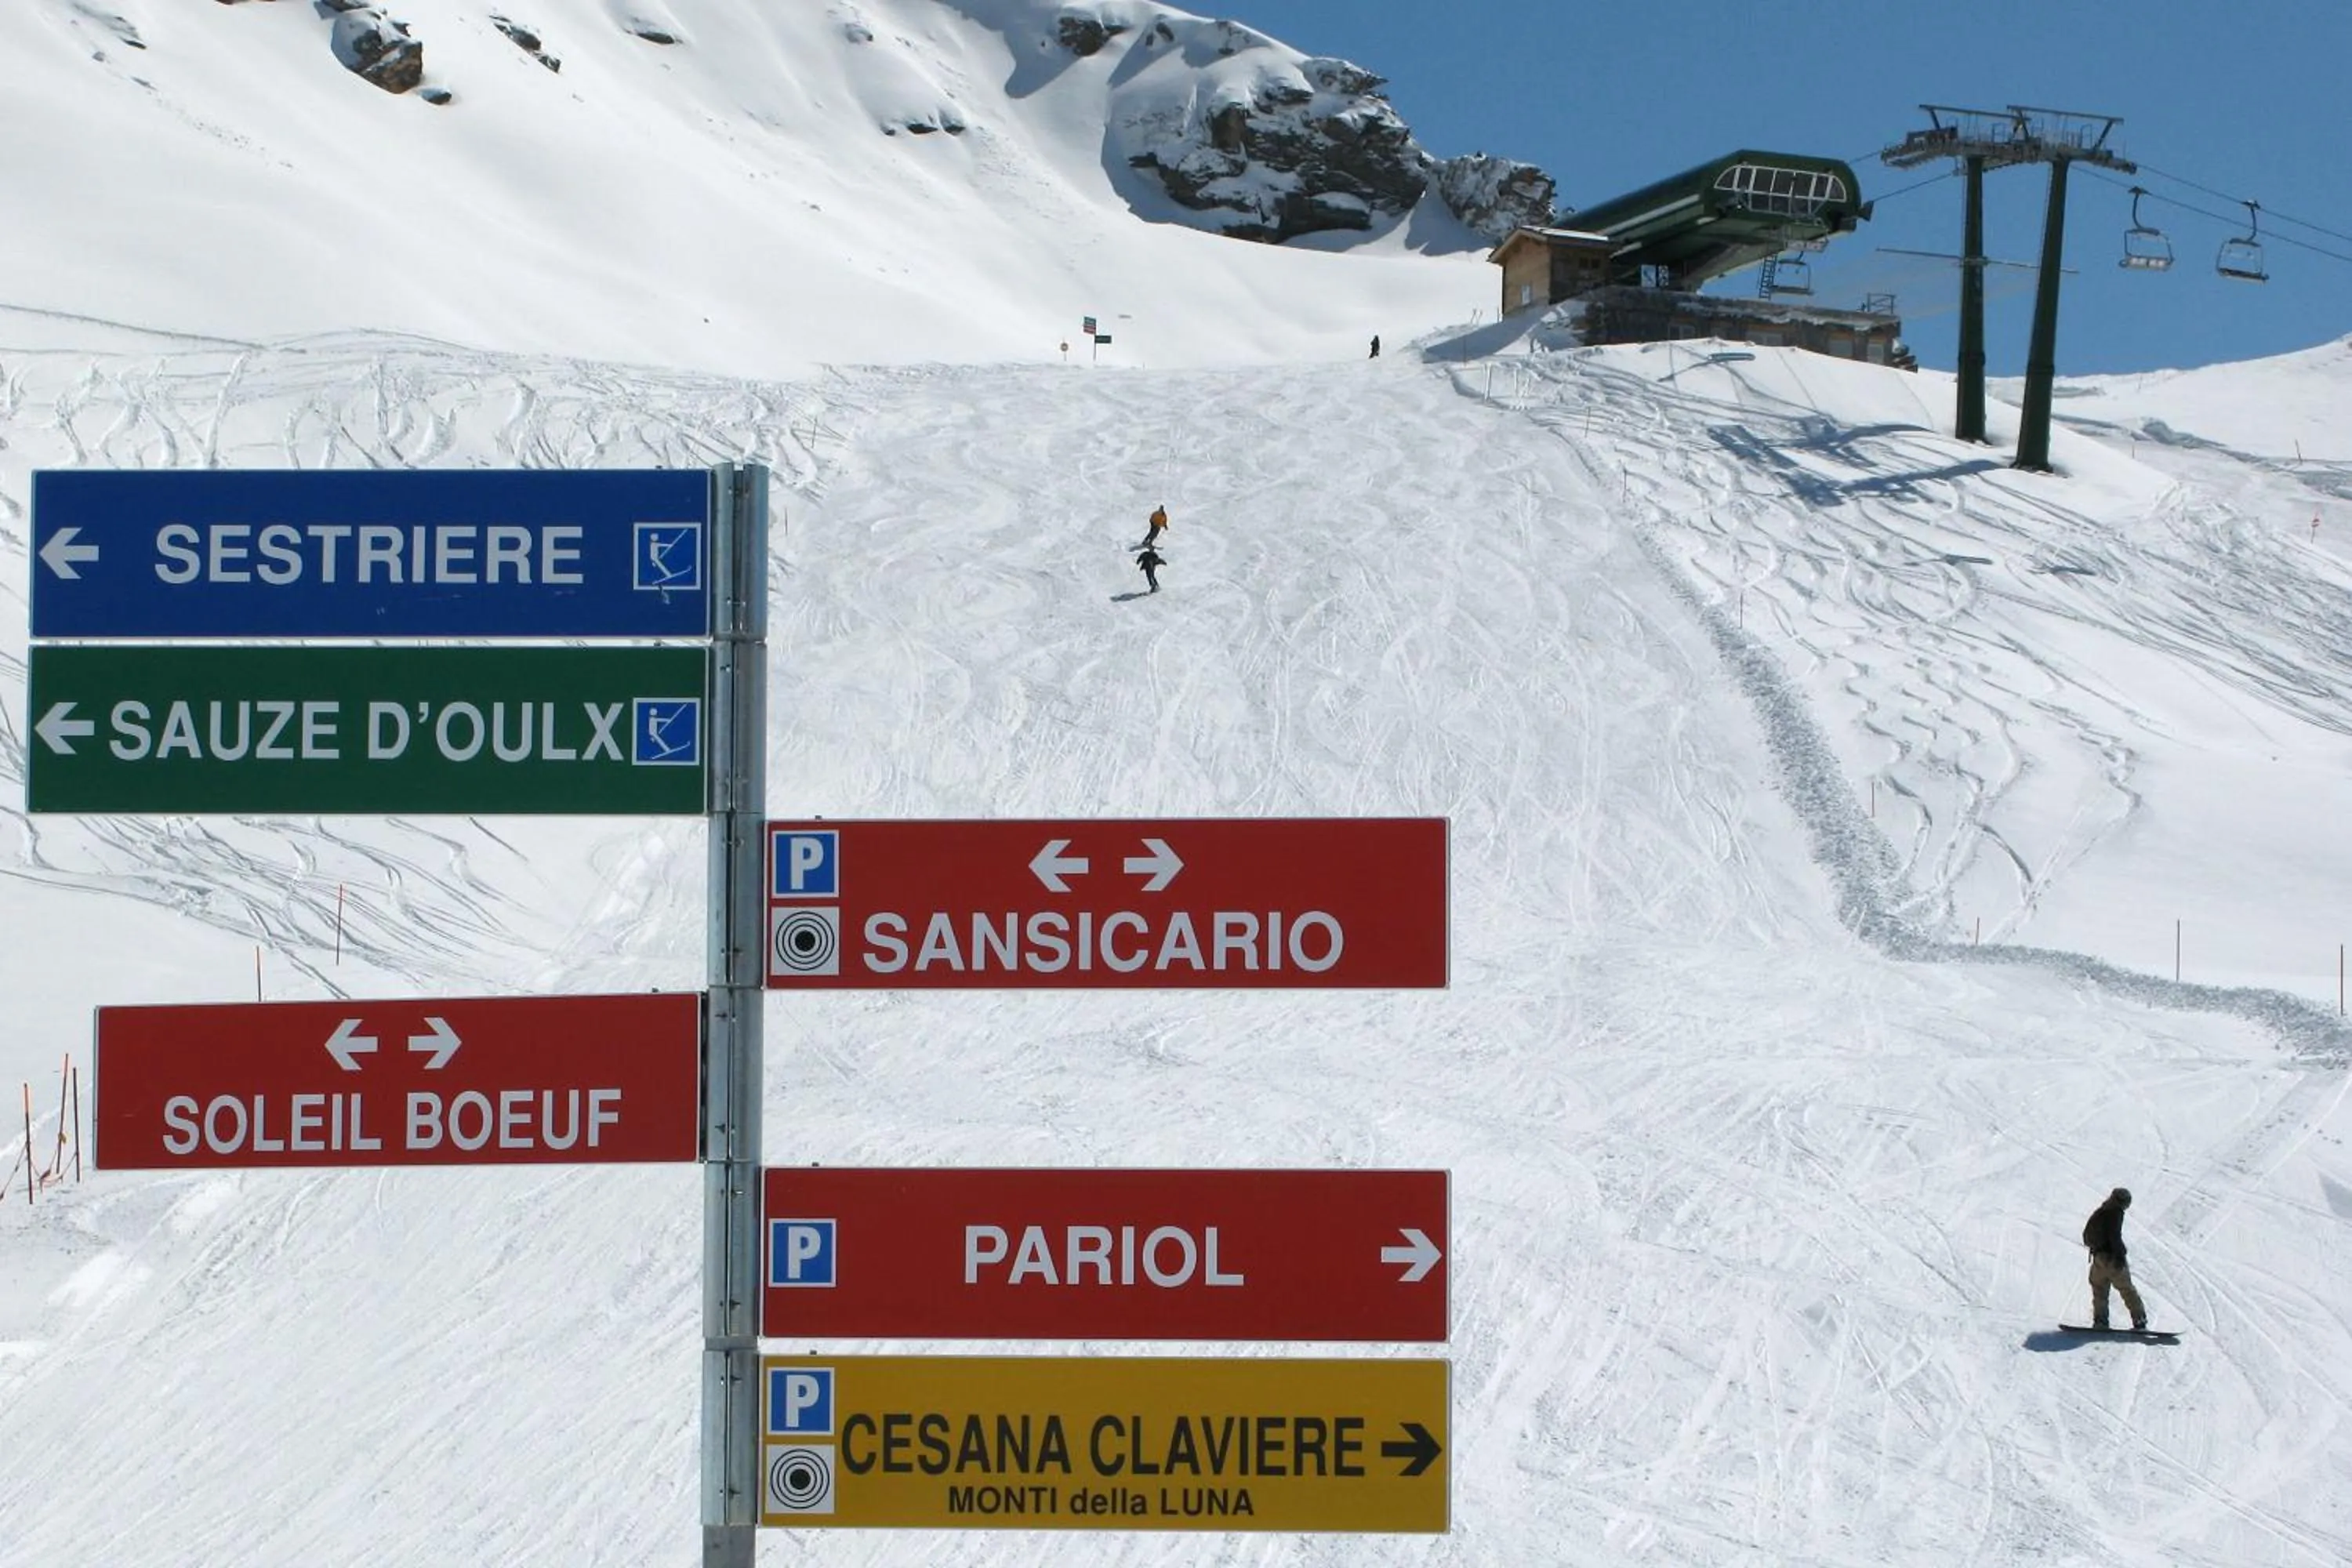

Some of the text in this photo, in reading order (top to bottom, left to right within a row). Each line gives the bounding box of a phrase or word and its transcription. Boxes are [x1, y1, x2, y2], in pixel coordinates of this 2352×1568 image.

[154, 524, 583, 585] SESTRIERE
[109, 700, 624, 762] SAUZE D'OULX
[790, 837, 824, 890] P
[863, 910, 1344, 973] SANSICARIO
[162, 1088, 622, 1155] SOLEIL BOEUF
[787, 1225, 822, 1279] P
[965, 1225, 1244, 1288] PARIOL
[786, 1374, 819, 1428] P
[841, 1413, 1366, 1477] CESANA CLAVIERE
[949, 1486, 1254, 1516] MONTI della LUNA
